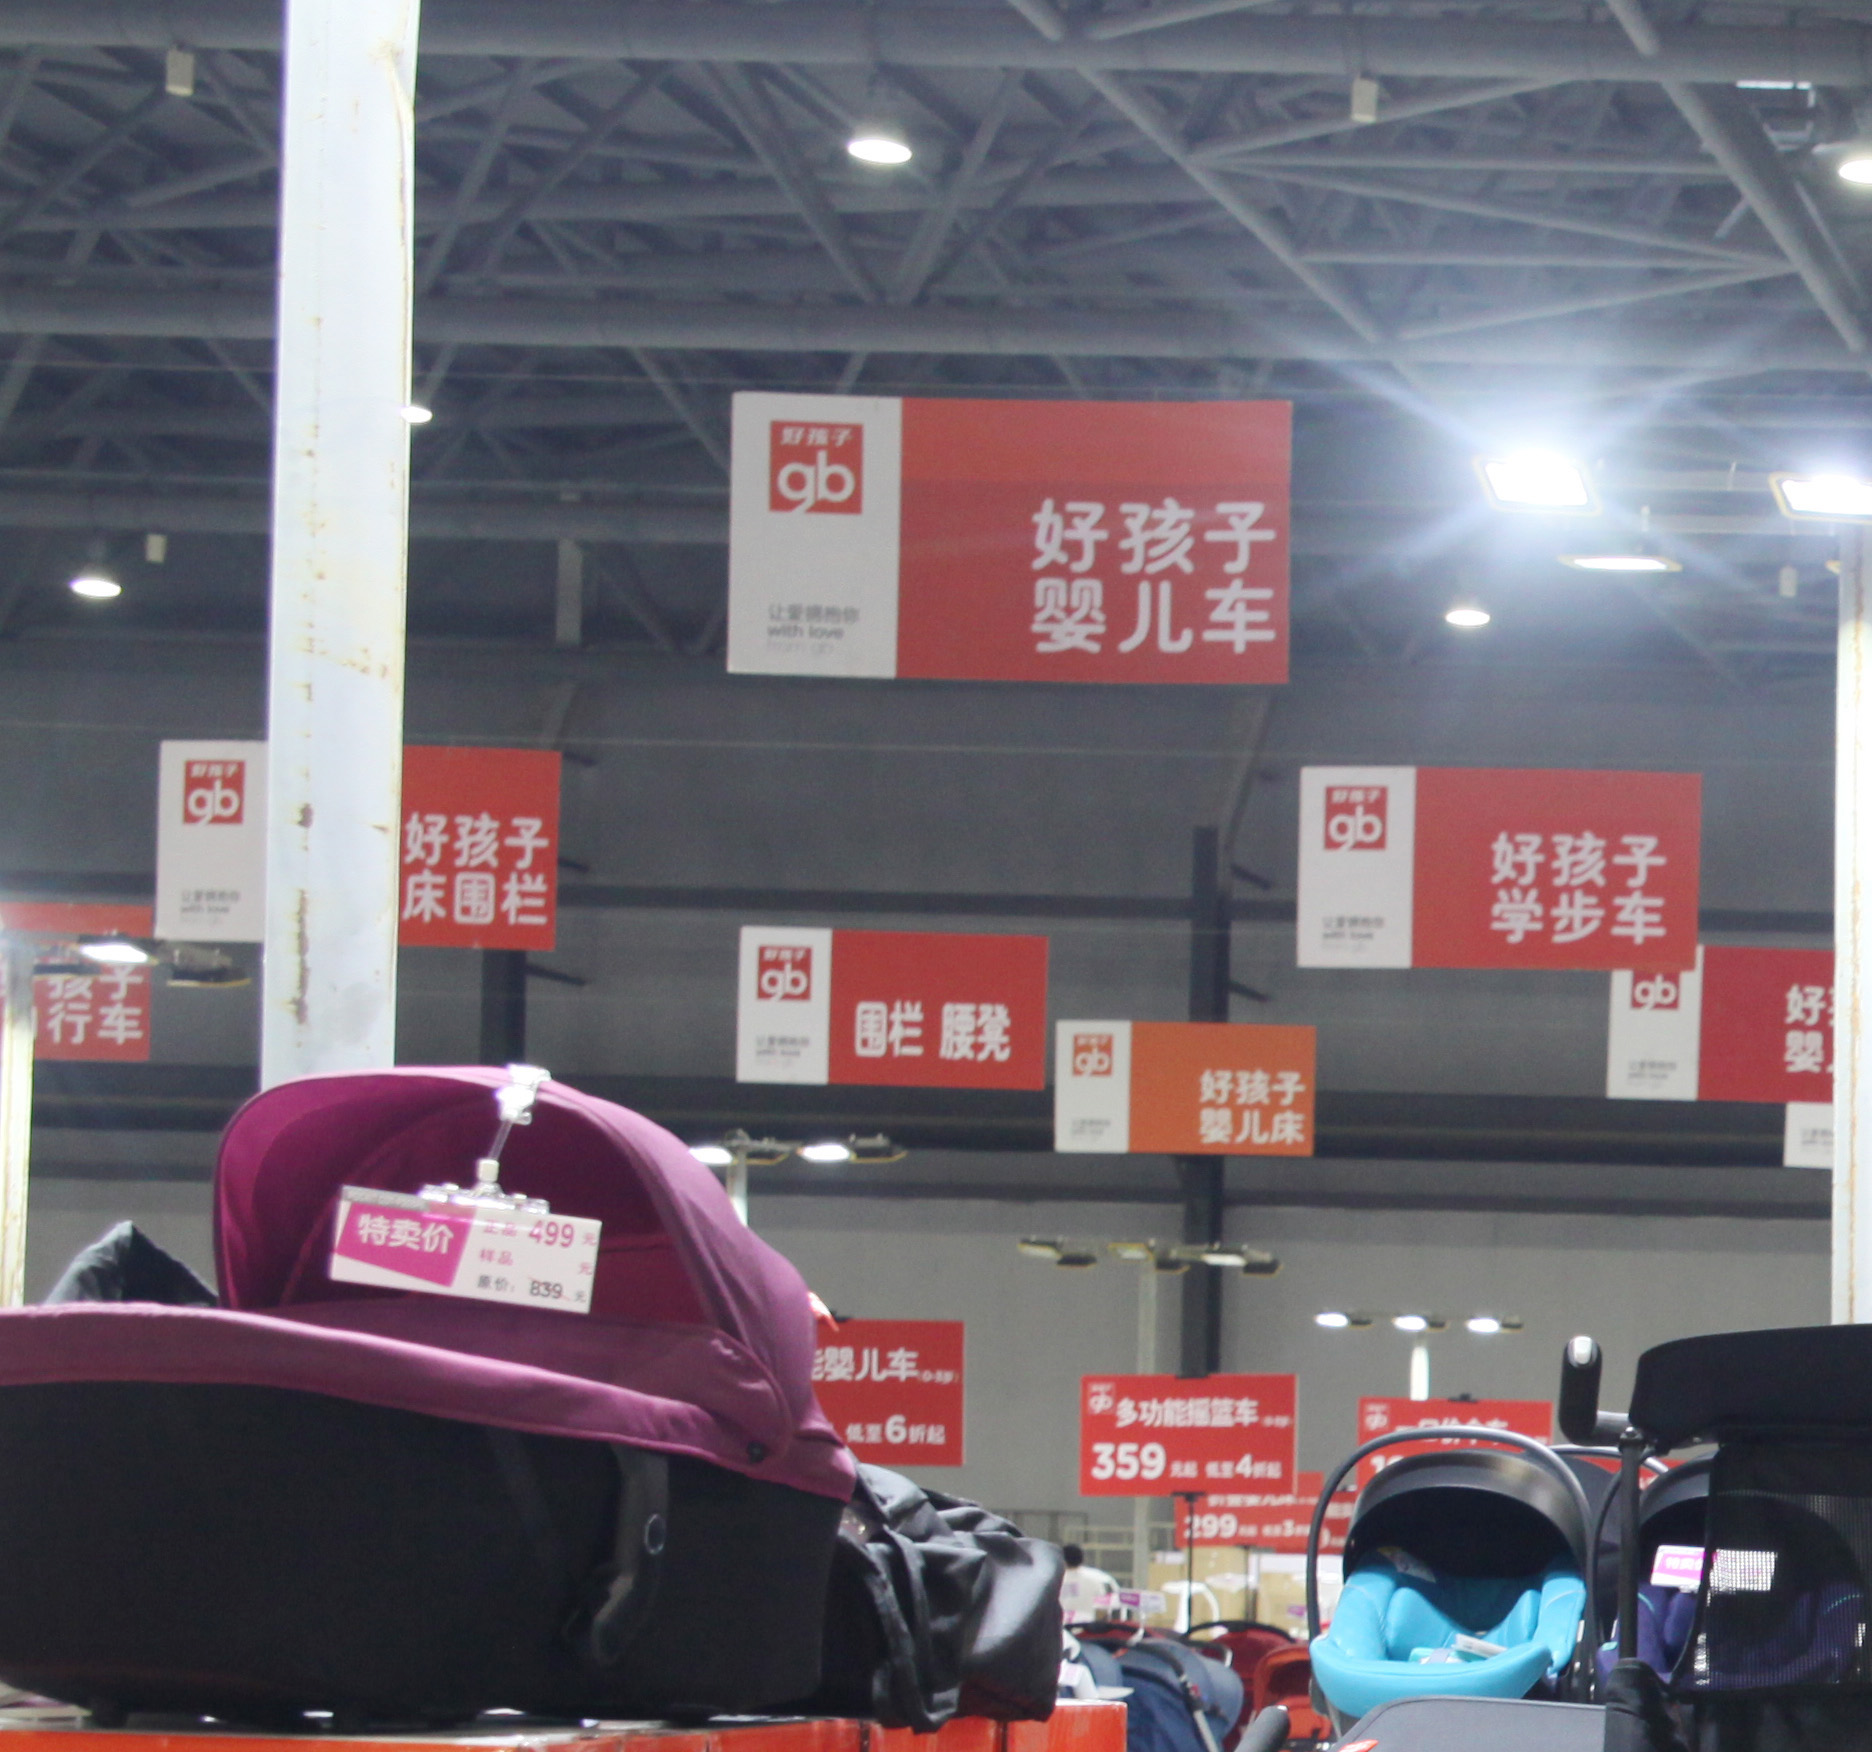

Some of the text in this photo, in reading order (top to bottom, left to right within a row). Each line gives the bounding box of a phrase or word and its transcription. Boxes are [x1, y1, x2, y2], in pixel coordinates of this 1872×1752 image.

[777, 449, 855, 514] gb
[1031, 496, 1277, 574] 好孩子
[1029, 578, 1277, 656] 婴儿车
[187, 779, 240, 825] gb
[1327, 805, 1382, 851] gb
[403, 812, 550, 870] 好孩子
[1490, 830, 1667, 888] 好孩子
[402, 867, 549, 926] 床围栏
[1490, 888, 1667, 945] 学步车
[759, 960, 811, 1001] gb
[854, 1000, 924, 1058] 围栏
[938, 1002, 1013, 1061] 腰凳
[1199, 1067, 1306, 1104] 好孩子
[1197, 1108, 1306, 1146] 婴儿床
[357, 1213, 454, 1254] 特卖价
[528, 1219, 575, 1249] 499
